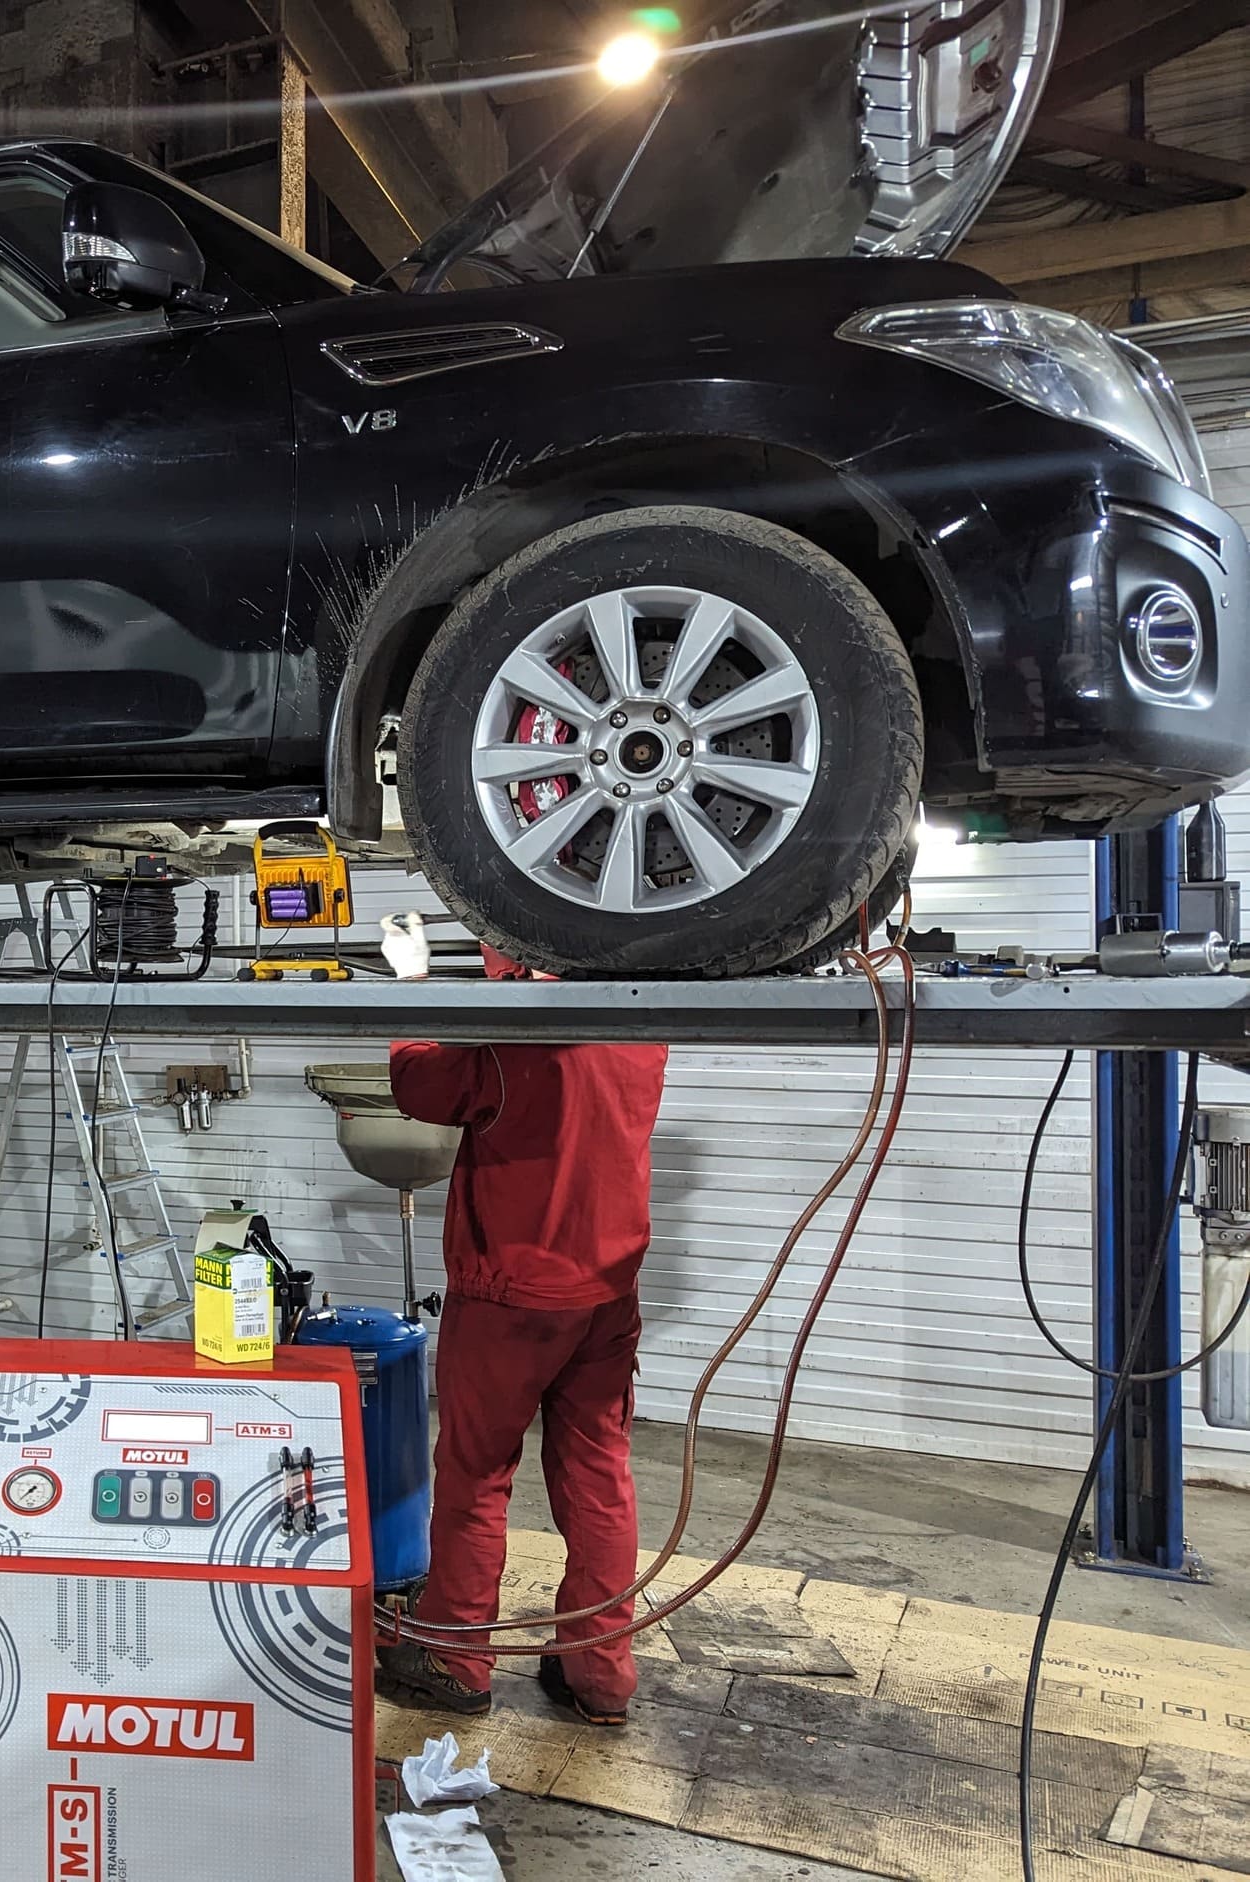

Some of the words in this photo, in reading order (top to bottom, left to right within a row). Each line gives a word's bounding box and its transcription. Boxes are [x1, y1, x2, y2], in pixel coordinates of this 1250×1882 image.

[342, 410, 397, 434] V8
[195, 1256, 223, 1274] MANN
[195, 1269, 223, 1287] FILTER
[237, 1343, 249, 1353] WD
[250, 1341, 270, 1352] 724/6
[240, 1425, 287, 1436] ATM-S
[125, 1450, 186, 1464] MOTUL
[1019, 1652, 1090, 1671] PWER
[1098, 1666, 1143, 1681] UNIT
[56, 1702, 245, 1752] MOTUL
[107, 1787, 117, 1878] TRANSMISSION
